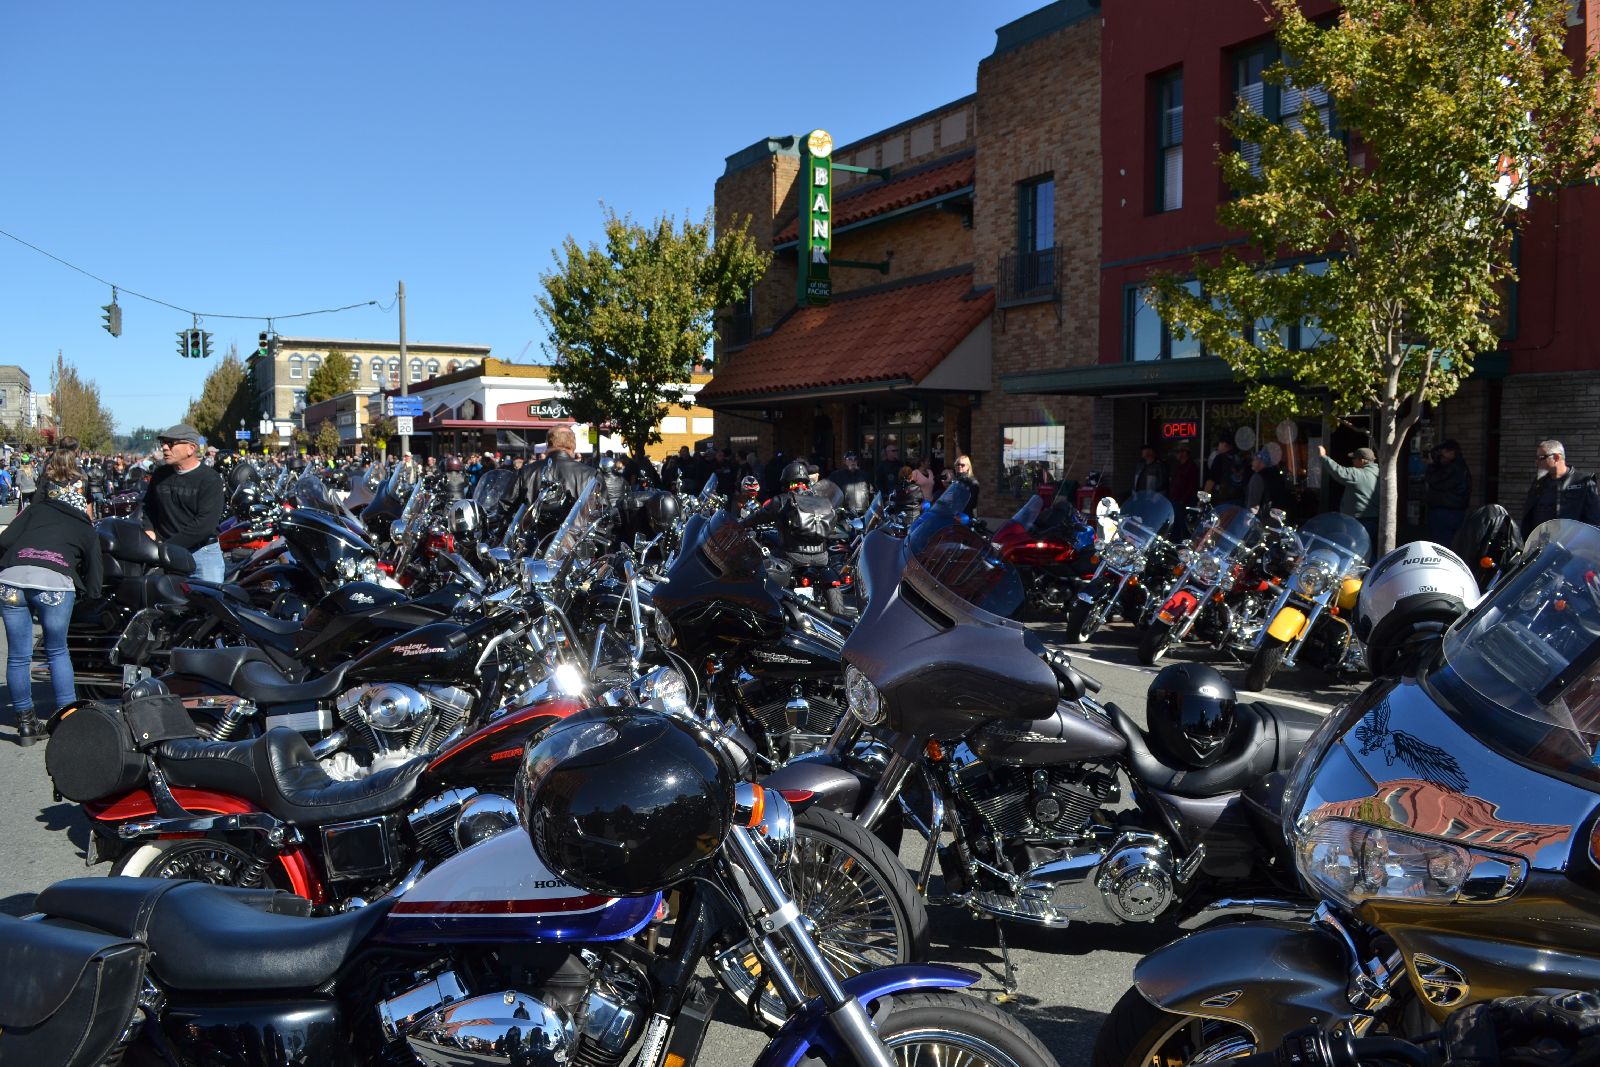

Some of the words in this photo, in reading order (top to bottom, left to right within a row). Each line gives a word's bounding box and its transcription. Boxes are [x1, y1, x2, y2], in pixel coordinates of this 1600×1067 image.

[813, 167, 829, 264] BANK
[530, 405, 553, 415] ELSA
[1152, 405, 1199, 419] PIZZA
[399, 425, 412, 433] 20
[1163, 423, 1197, 438] OPEN
[1402, 556, 1442, 566] NOLAN
[534, 880, 570, 889] HON
